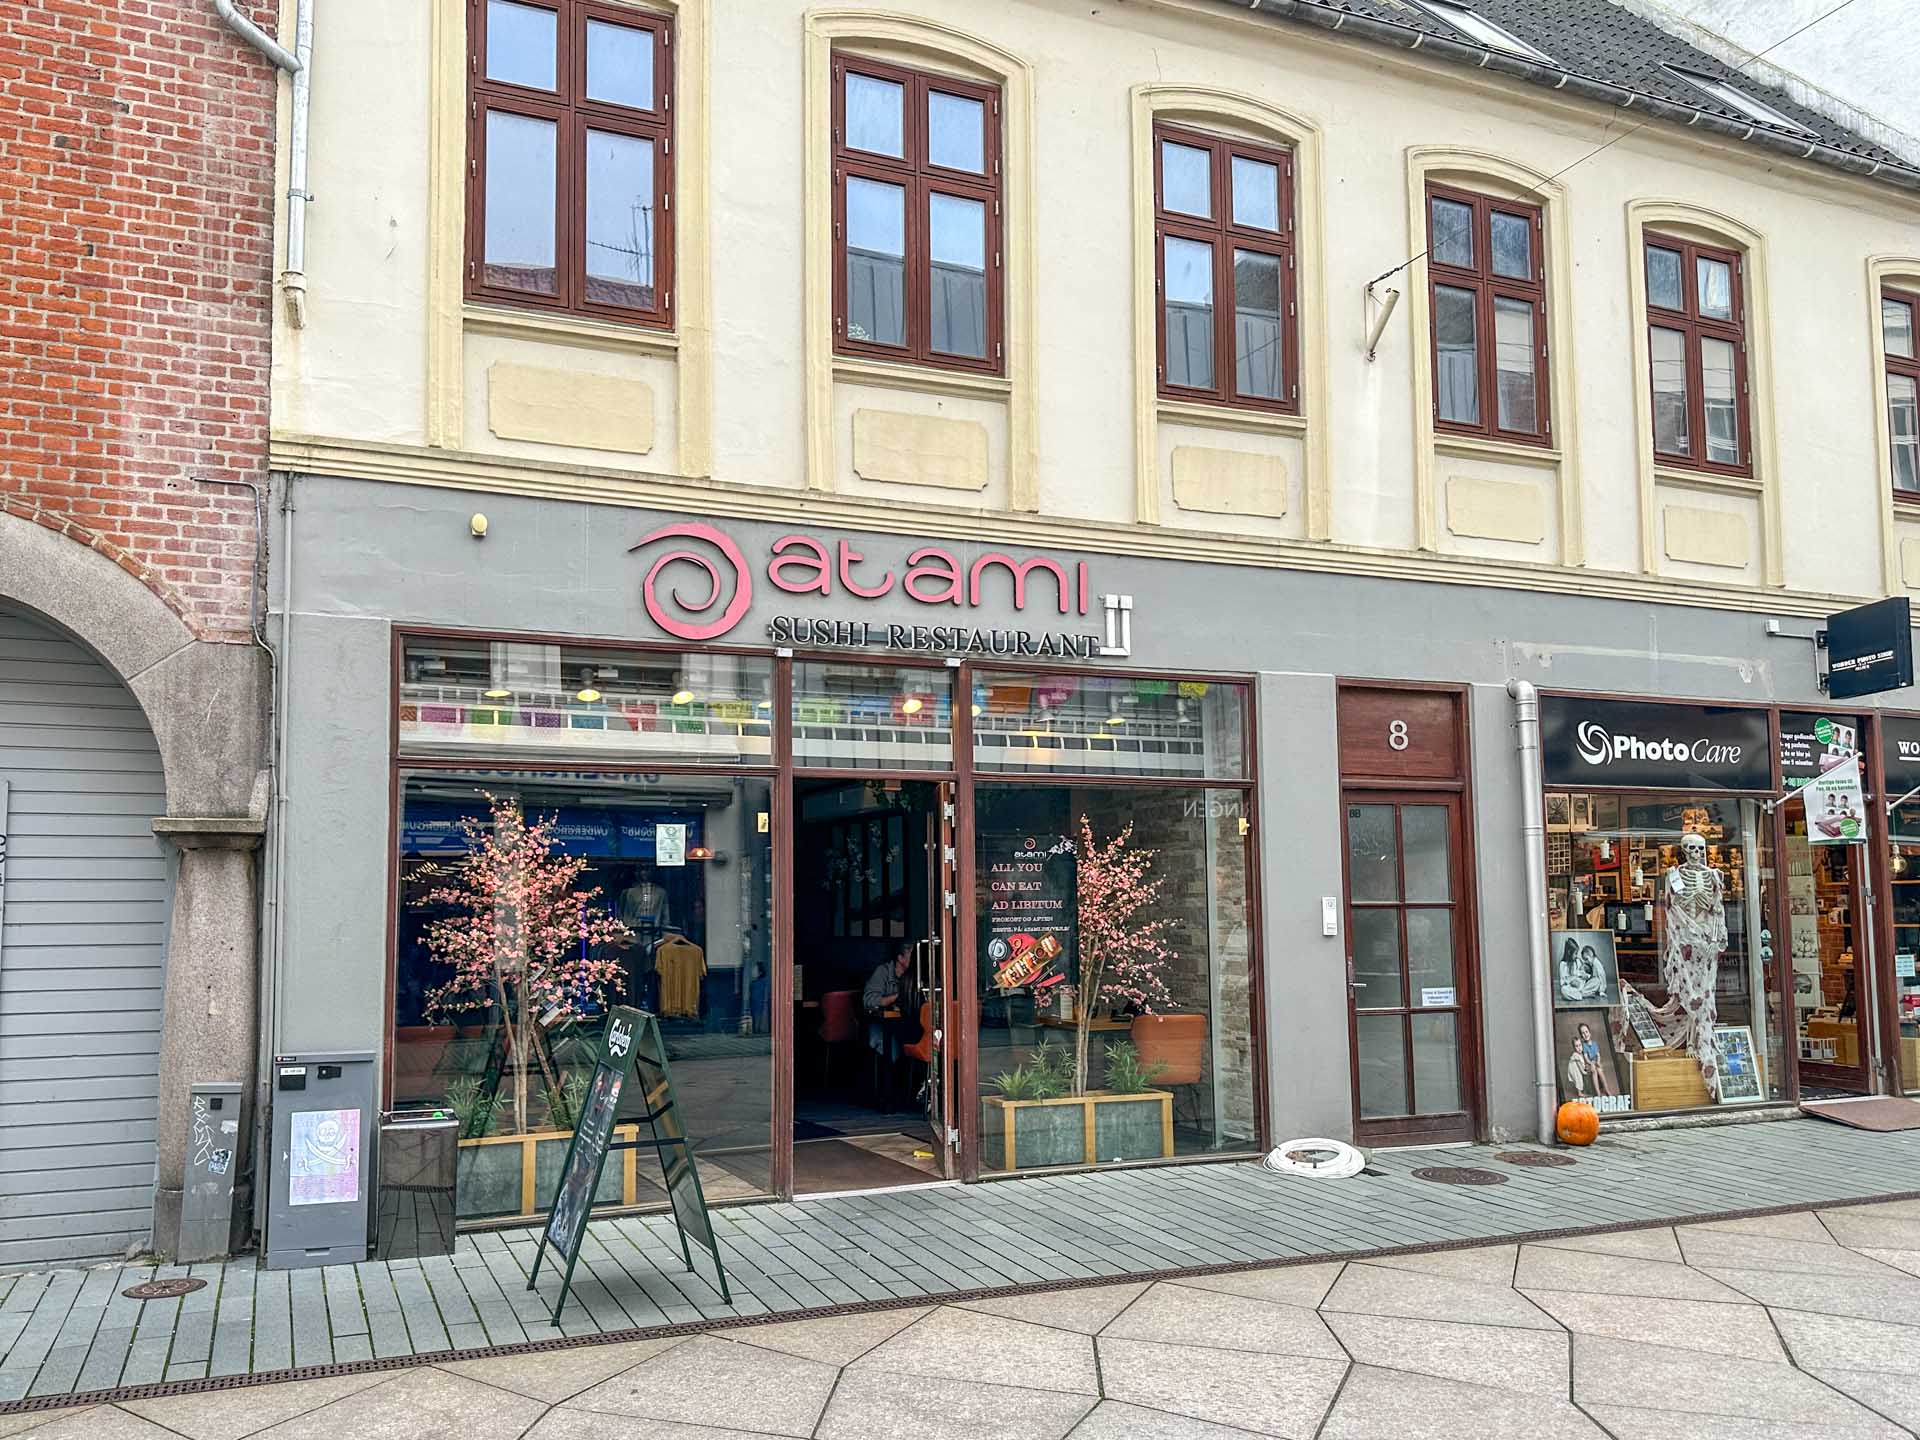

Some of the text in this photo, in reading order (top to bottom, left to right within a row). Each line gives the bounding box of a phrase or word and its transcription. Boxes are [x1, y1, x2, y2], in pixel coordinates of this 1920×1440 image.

[768, 535, 1089, 616] atami
[771, 615, 1099, 660] SUSHI RESTAURANT
[1388, 720, 1409, 751] 8
[991, 863, 1043, 872] ALL YOU
[991, 881, 1042, 891] CAN EAT
[991, 900, 1063, 910] AD LIBITUM
